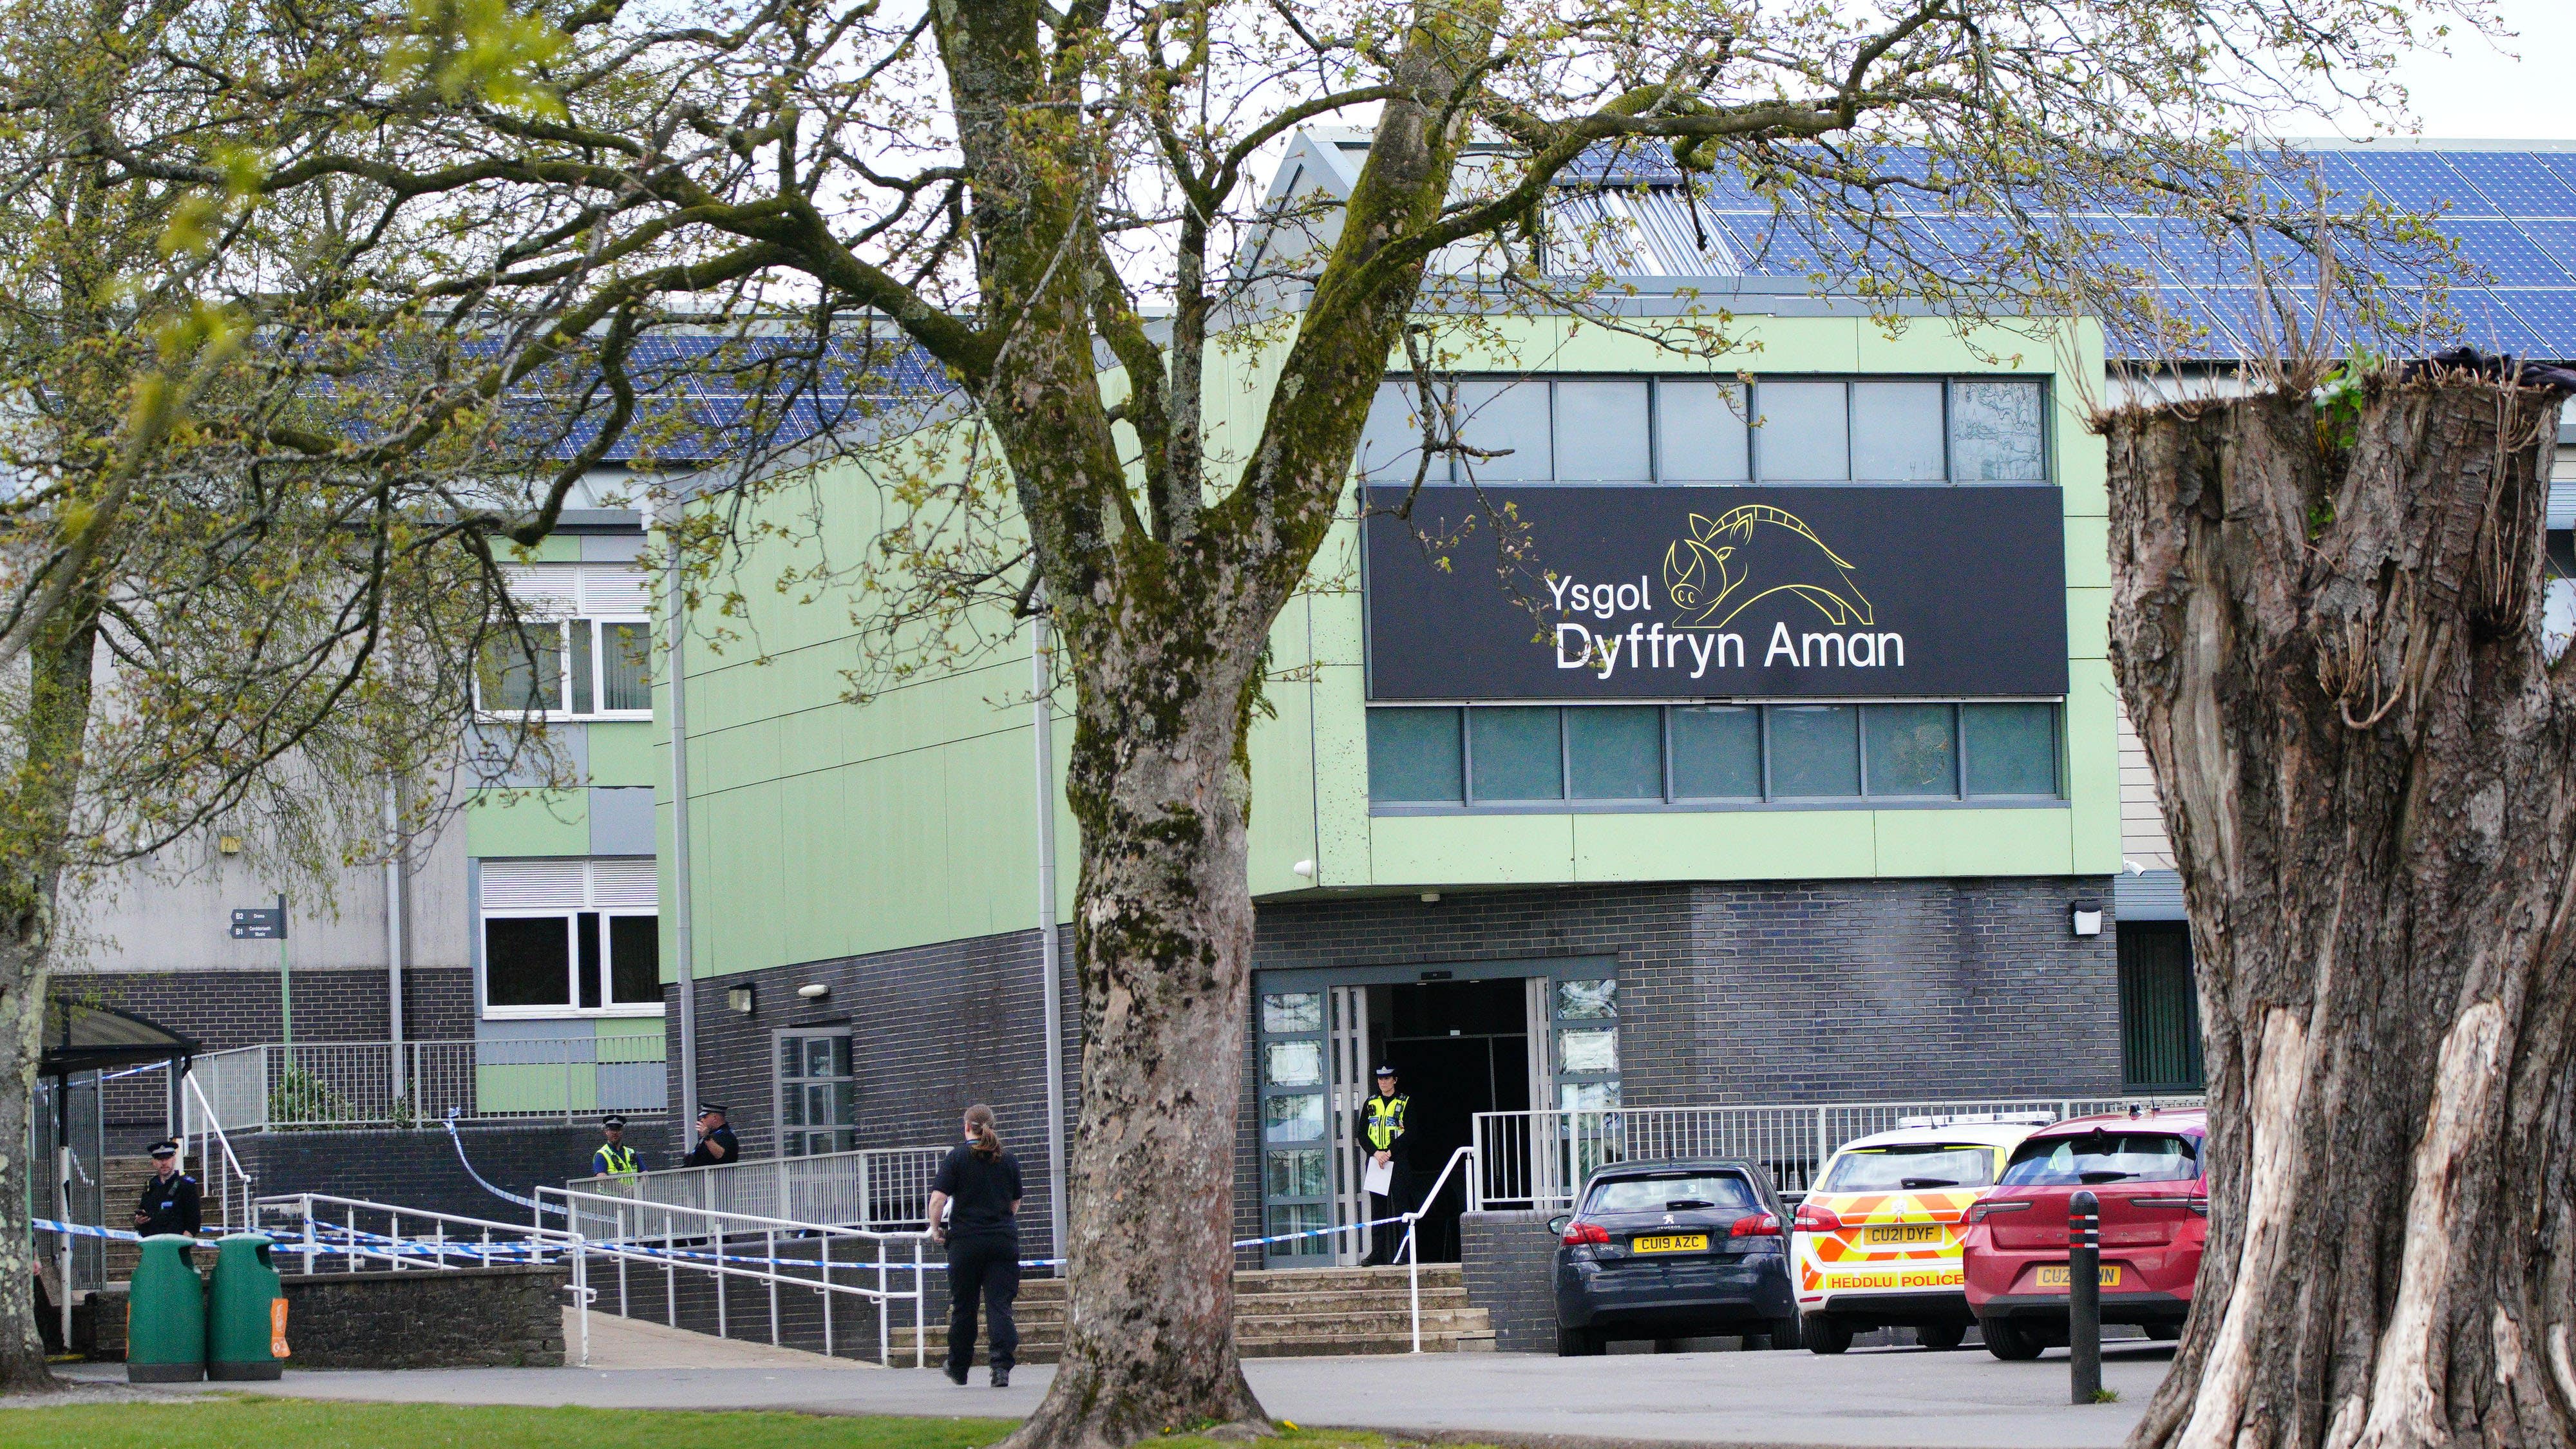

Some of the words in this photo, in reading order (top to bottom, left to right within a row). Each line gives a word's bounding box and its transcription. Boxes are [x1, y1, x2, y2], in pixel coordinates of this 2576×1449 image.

[1546, 575, 1651, 619] Ysgol
[1557, 621, 1745, 679] Dyffryn
[1764, 621, 1904, 667] Aman
[1871, 1228, 1903, 1242] CU21
[1907, 1227, 1935, 1241] DYF
[1642, 1238, 1671, 1250] CU19
[1674, 1236, 1700, 1248] AZC
[1832, 1277, 1892, 1288] HEDDLU
[1902, 1274, 1964, 1287] POLICE
